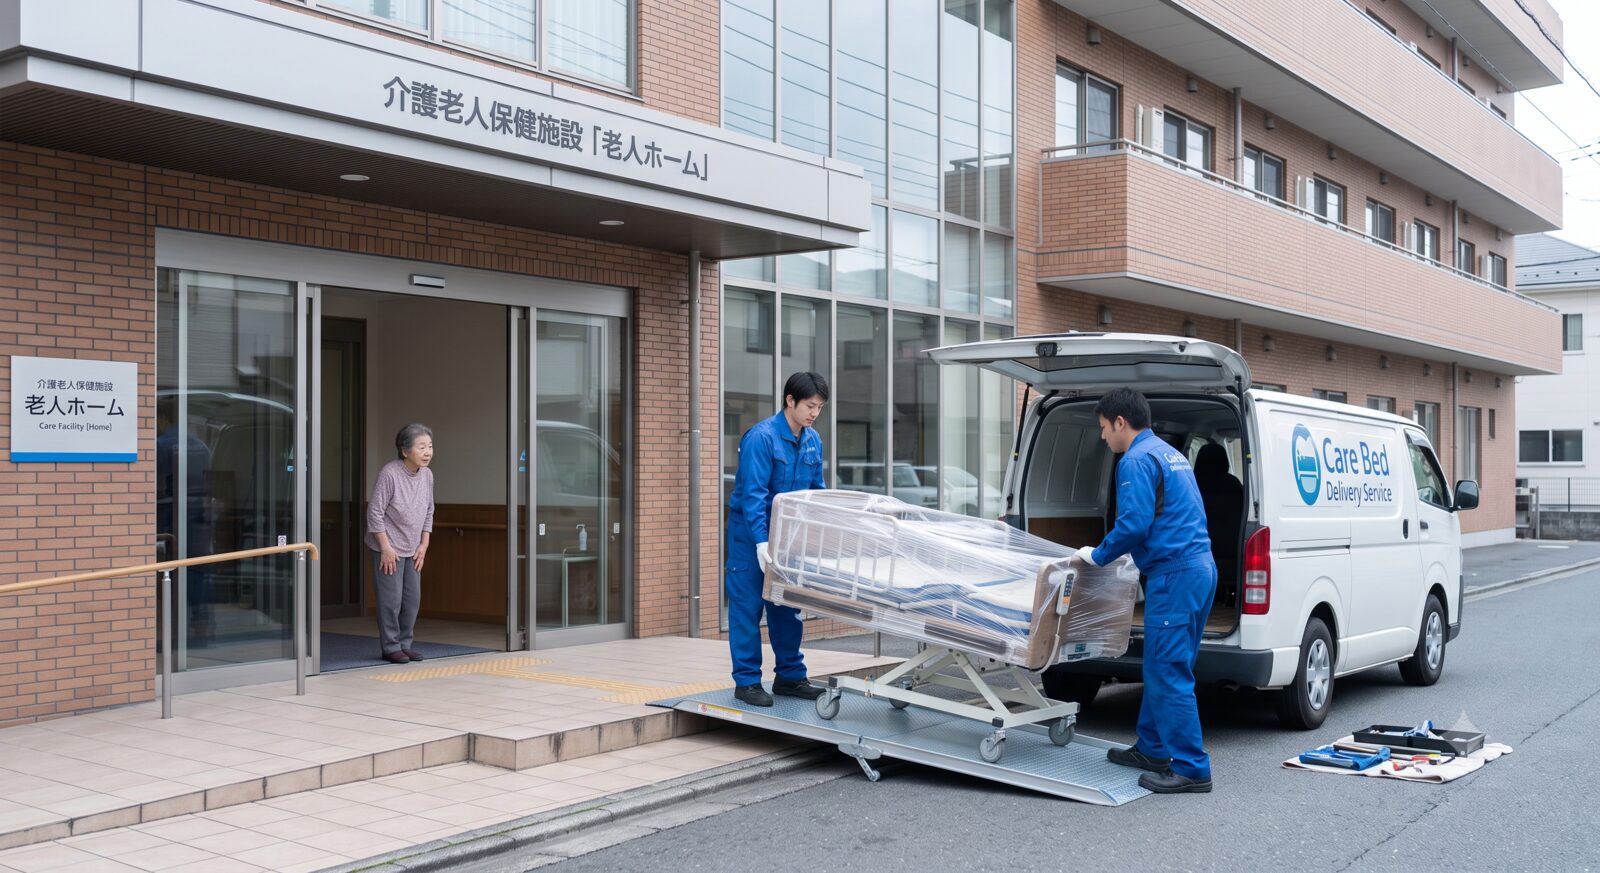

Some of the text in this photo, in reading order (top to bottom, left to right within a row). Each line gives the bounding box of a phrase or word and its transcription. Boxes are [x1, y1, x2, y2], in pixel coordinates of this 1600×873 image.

[25, 394, 124, 416] 老人ホーム
[39, 422, 112, 432] Care Facility [Home]
[1323, 437, 1390, 476] Care Bed
[1326, 480, 1393, 508] Delivery Service
